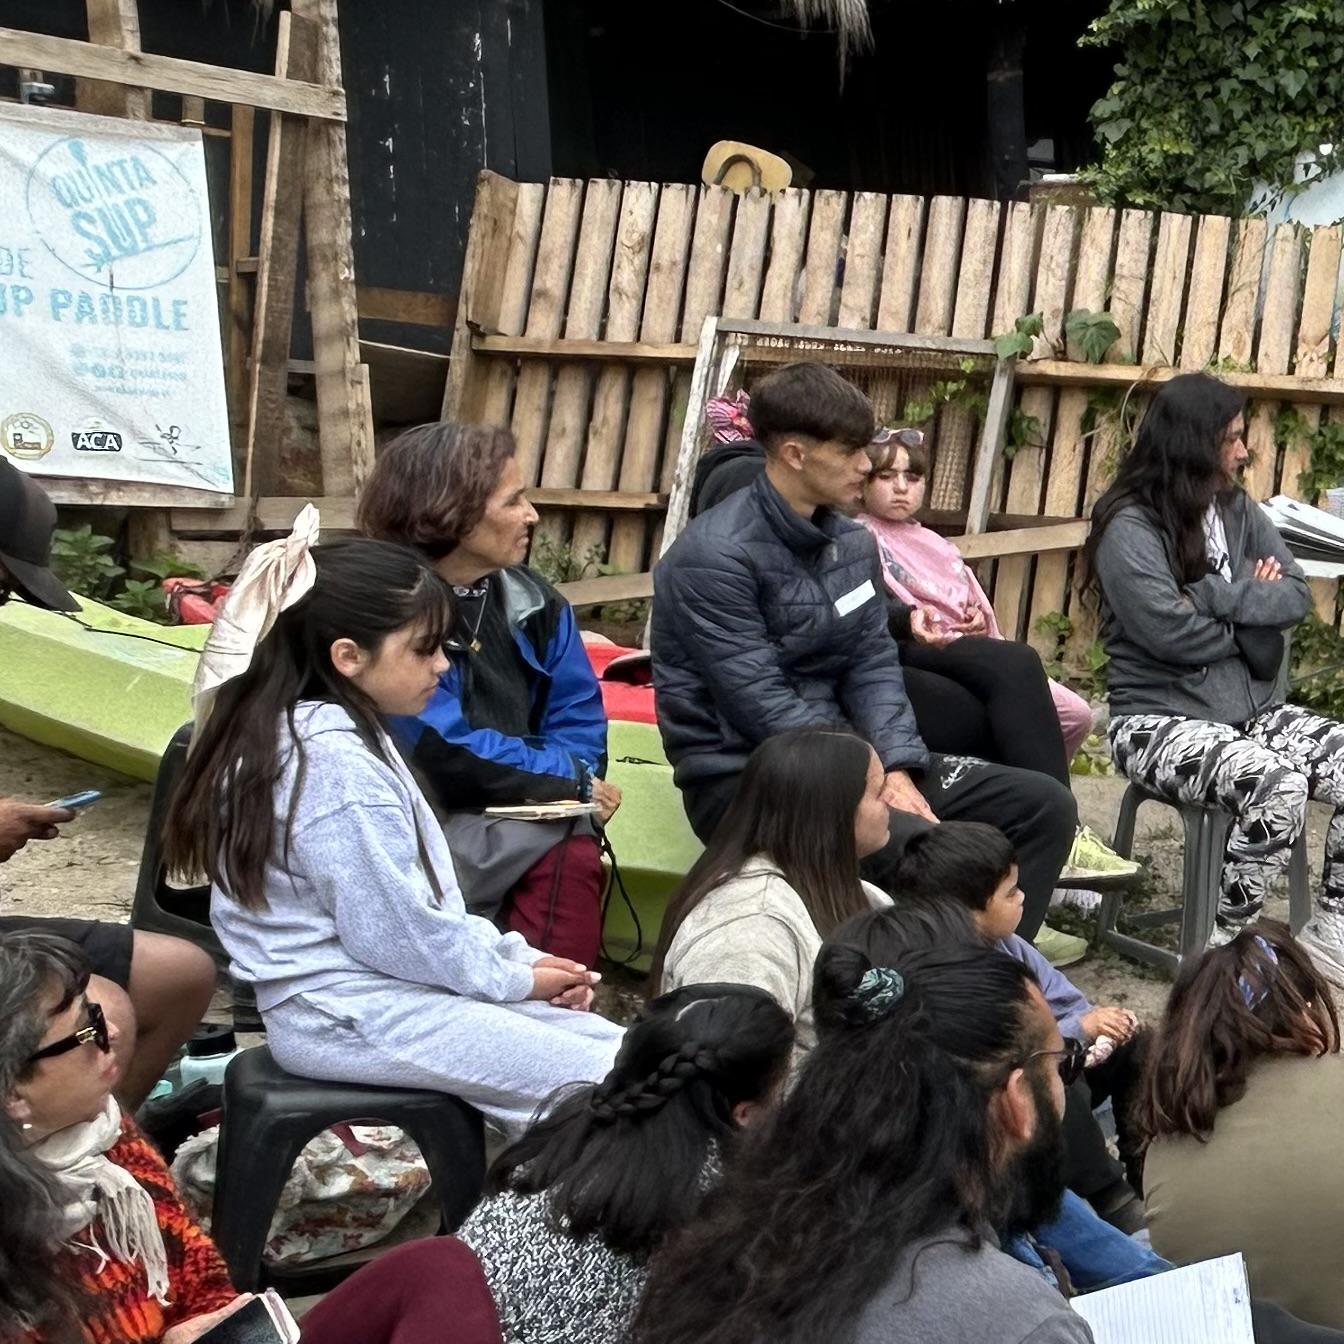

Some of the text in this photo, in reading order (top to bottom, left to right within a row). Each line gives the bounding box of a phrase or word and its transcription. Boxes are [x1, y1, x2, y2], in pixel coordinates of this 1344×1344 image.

[52, 155, 158, 209] QUINTA
[71, 197, 157, 262] SUP
[50, 287, 190, 331] PADDLE
[76, 434, 119, 450] ACA
